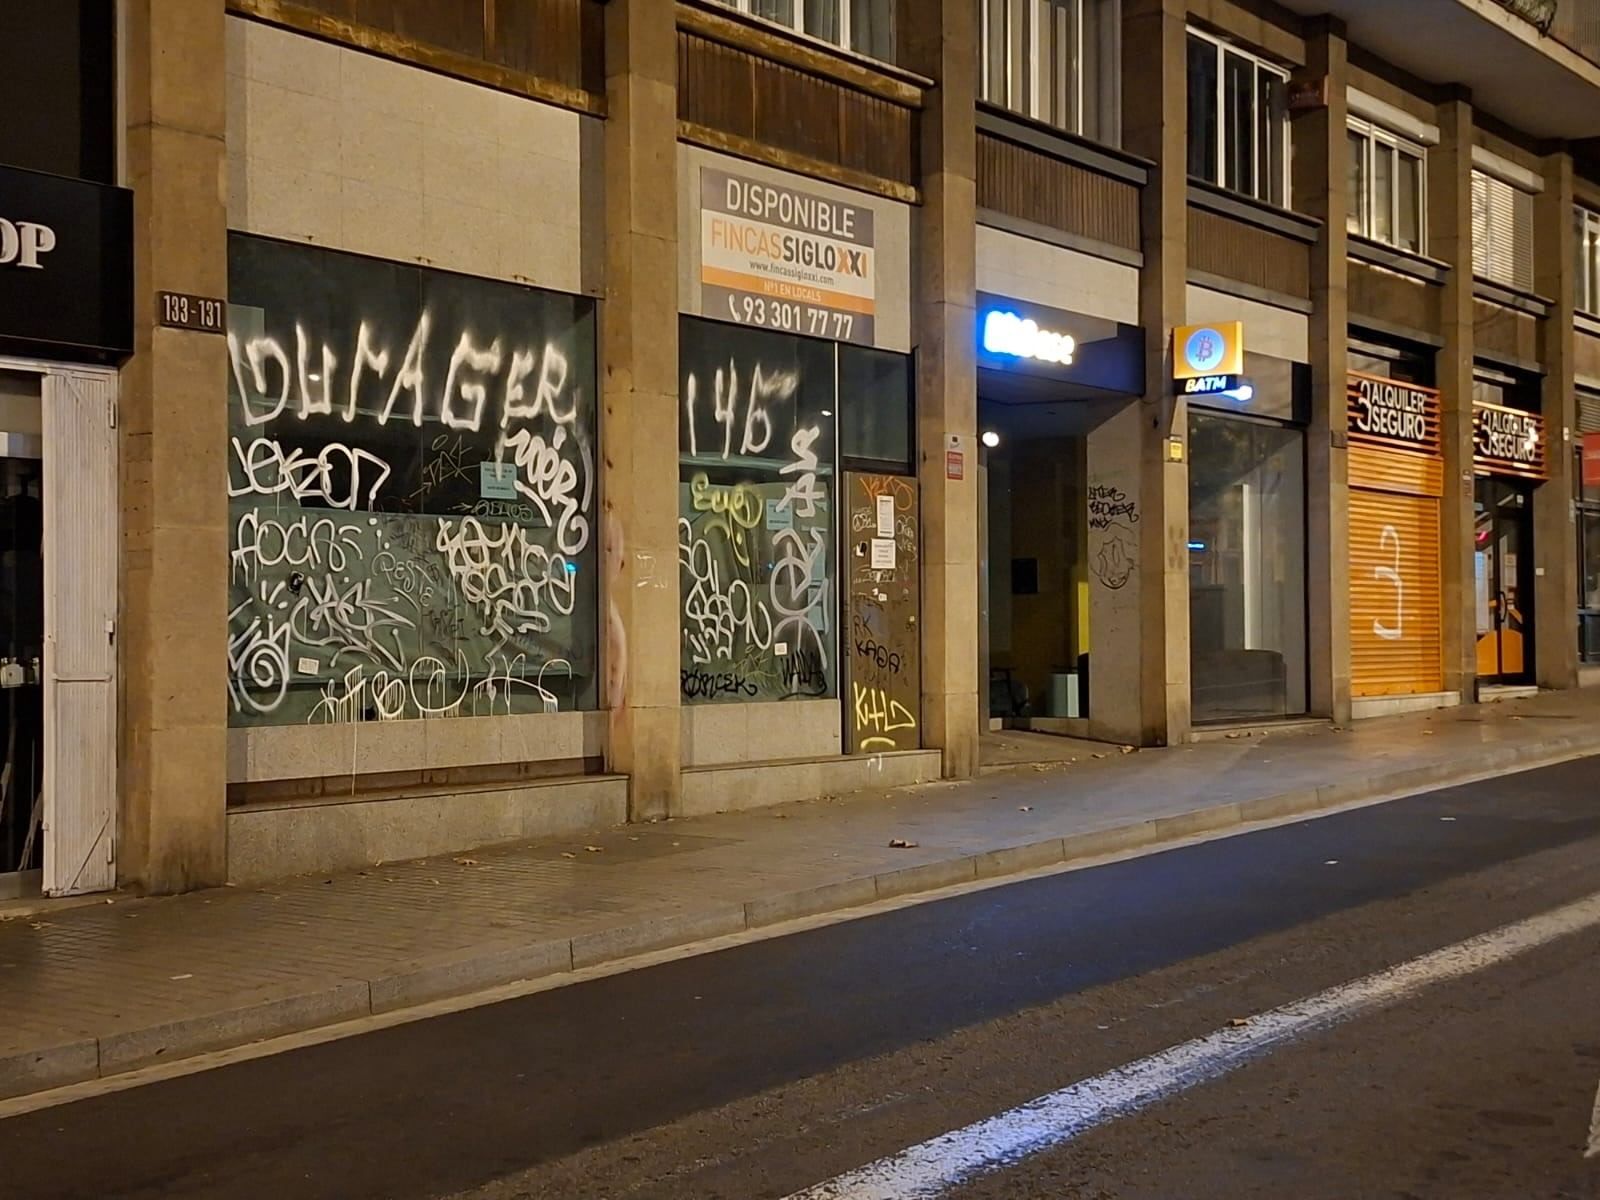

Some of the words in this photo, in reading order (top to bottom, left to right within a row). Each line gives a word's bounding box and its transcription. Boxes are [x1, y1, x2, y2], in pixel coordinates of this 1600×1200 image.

[726, 178, 855, 239] DISPONIBLE
[749, 260, 835, 286] www.fincassigloxxi.com
[743, 296, 766, 325] 93
[771, 301, 801, 332] 301
[807, 308, 829, 336] 77
[832, 313, 854, 340] 77
[1185, 375, 1227, 393] BATM
[1371, 383, 1426, 415] ALQUILER
[1372, 409, 1426, 441] SEGURO
